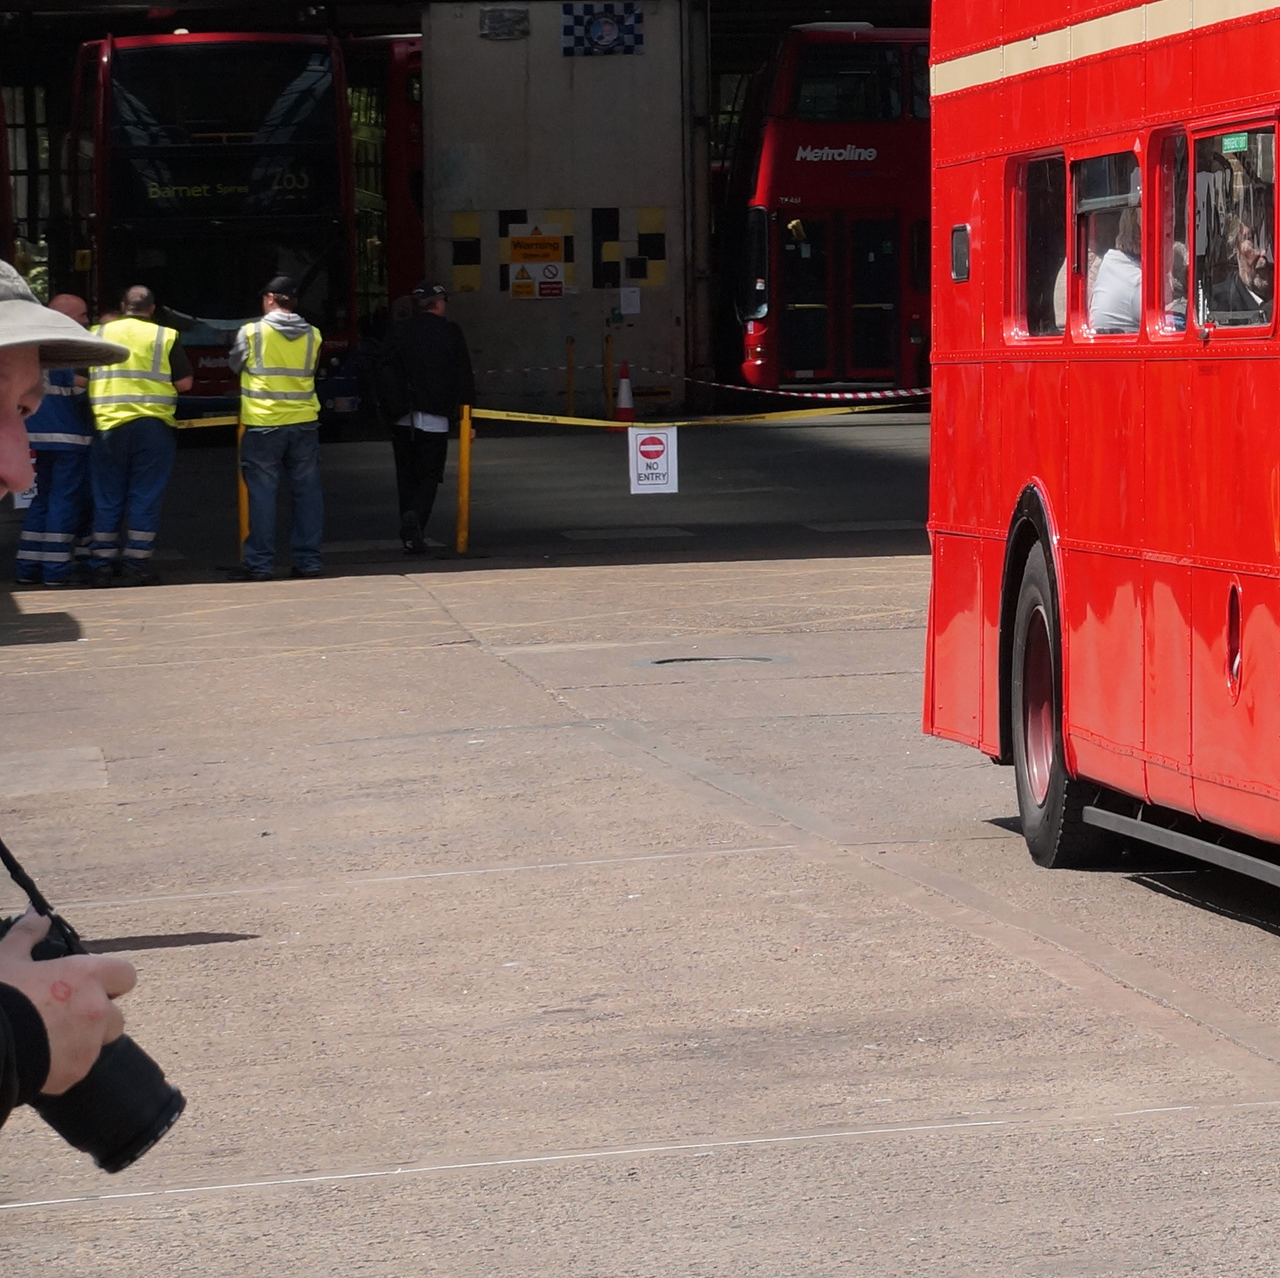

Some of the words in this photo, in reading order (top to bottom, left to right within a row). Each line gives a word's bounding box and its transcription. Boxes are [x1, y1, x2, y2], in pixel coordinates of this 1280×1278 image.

[795, 144, 877, 162] Metroline
[146, 181, 210, 199] Barnet
[512, 240, 559, 251] Warning
[645, 461, 659, 472] NO
[637, 472, 668, 482] ENTRY
